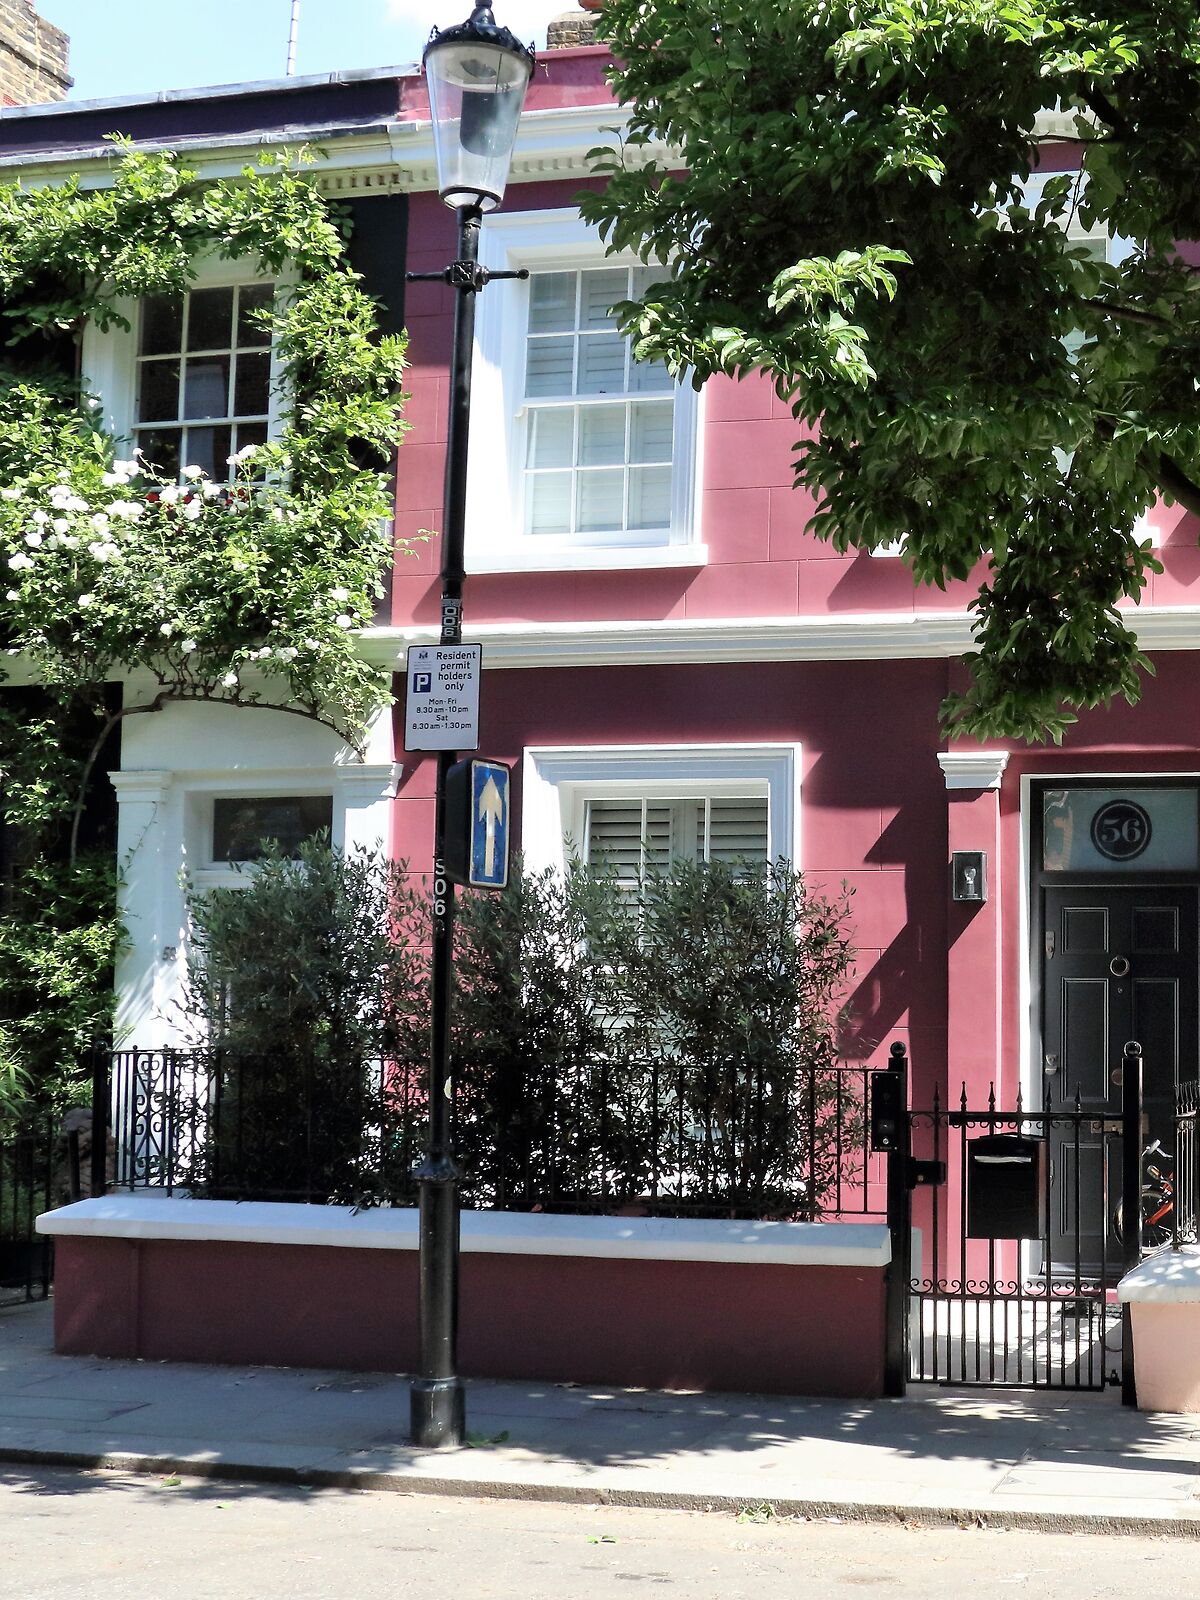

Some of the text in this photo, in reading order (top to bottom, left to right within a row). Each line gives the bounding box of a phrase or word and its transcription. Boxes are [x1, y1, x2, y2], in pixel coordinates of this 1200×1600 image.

[437, 651, 476, 660] Resident
[440, 661, 470, 671] permit
[438, 672, 472, 680] holders
[416, 674, 429, 692] P
[445, 682, 464, 691] only
[1102, 818, 1141, 843] 56
